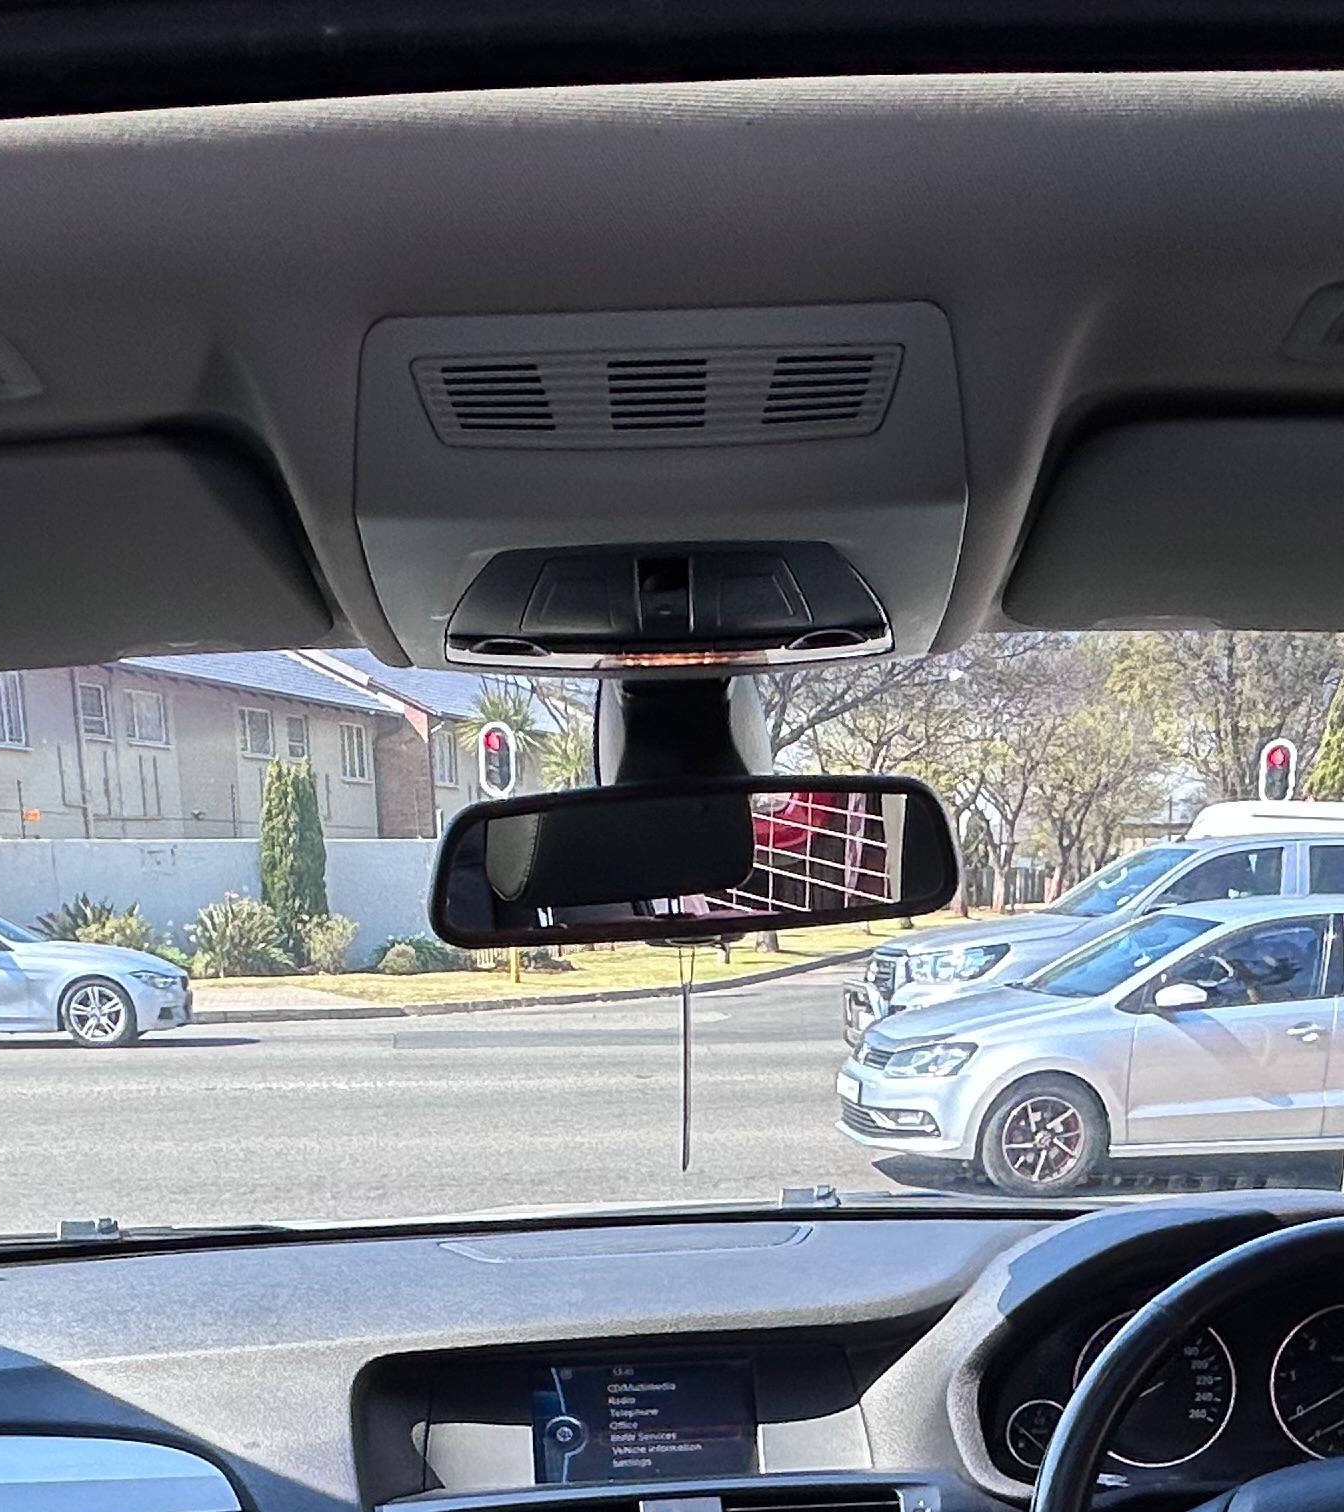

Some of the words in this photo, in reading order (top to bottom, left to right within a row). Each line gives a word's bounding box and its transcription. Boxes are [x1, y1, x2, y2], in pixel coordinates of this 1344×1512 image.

[608, 1396, 636, 1406] Radio
[1194, 1391, 1214, 1402] 240
[610, 1408, 659, 1418] Telephone
[1188, 1408, 1207, 1419] 260
[609, 1420, 638, 1430] Office
[637, 1432, 677, 1442] Services
[612, 1446, 647, 1455] Vehicle
[613, 1458, 652, 1468] Settings
